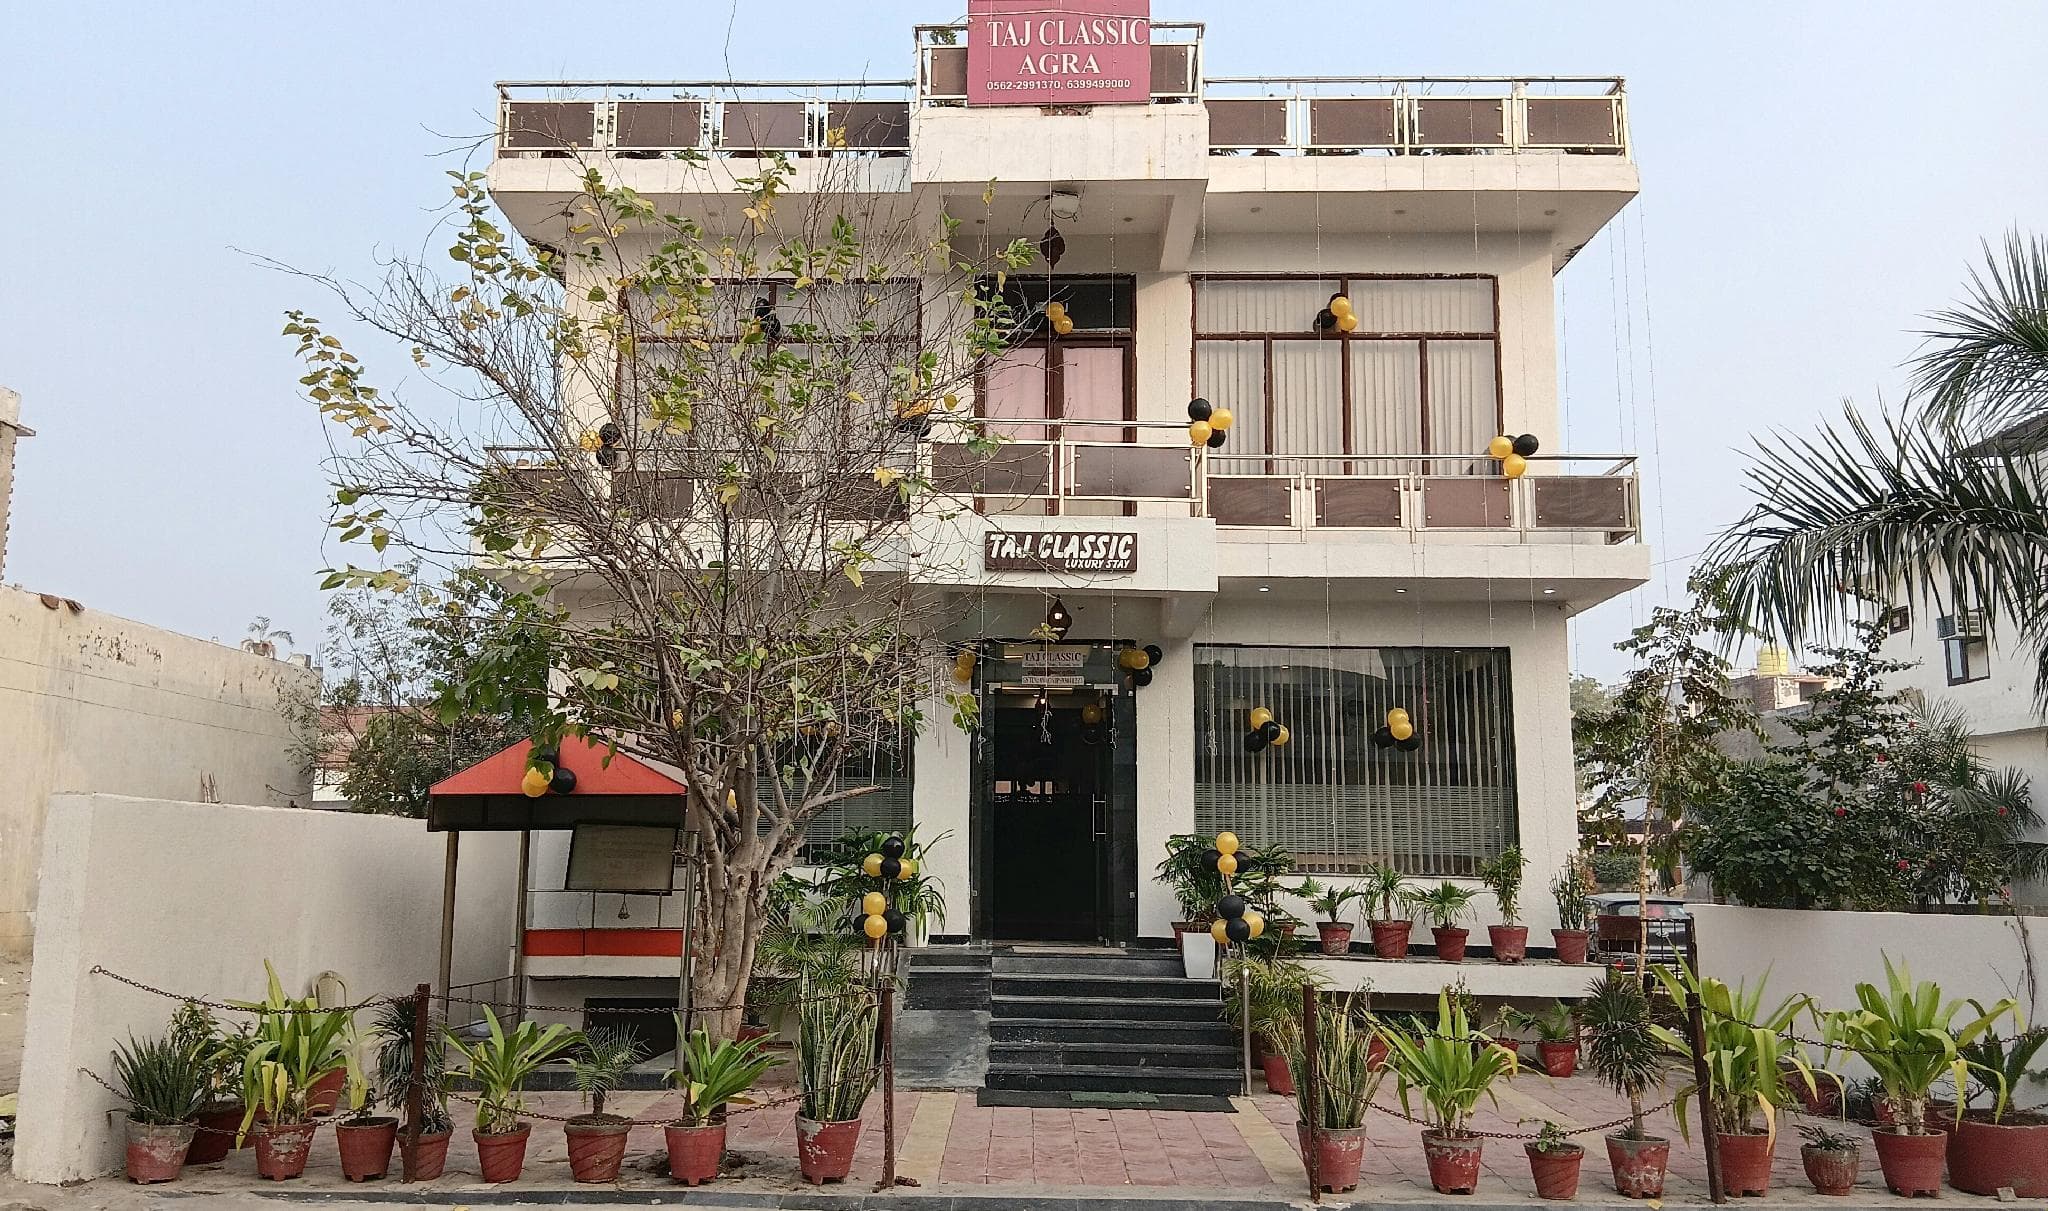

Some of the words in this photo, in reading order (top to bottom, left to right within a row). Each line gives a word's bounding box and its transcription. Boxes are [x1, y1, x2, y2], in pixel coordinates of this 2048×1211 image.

[987, 20, 1032, 47] TAJ
[1038, 18, 1147, 46] CLASSIC
[1017, 53, 1101, 75] AGRA
[986, 80, 1064, 91] 0562-2991370,
[1066, 79, 1131, 89] 6399499000
[990, 534, 1034, 559] TAJ
[1038, 534, 1134, 560] CLASSIC
[1064, 559, 1104, 569] LUXURY
[1105, 559, 1130, 569] STAY
[1024, 652, 1040, 662] TAJ
[1042, 652, 1082, 662] CLASSIC
